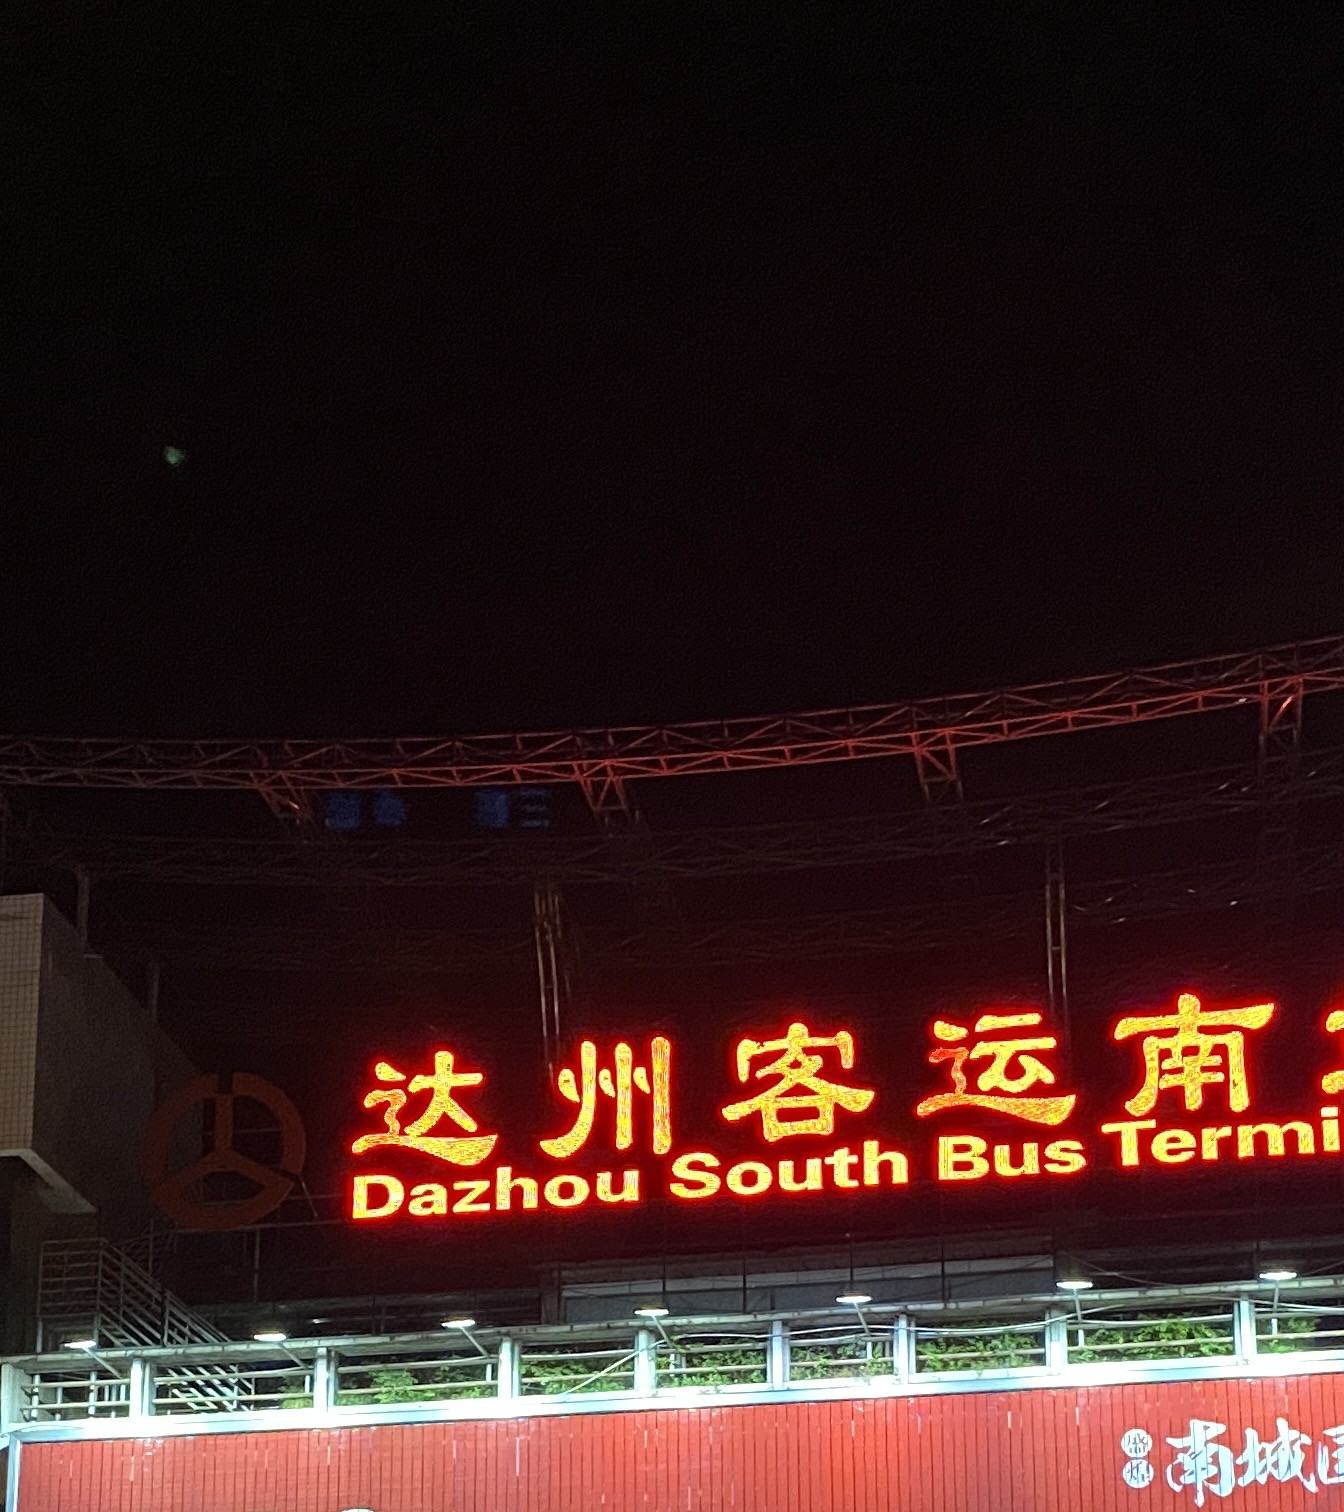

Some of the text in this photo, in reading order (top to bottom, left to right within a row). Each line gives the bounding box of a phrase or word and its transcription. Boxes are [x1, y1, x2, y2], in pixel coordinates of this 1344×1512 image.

[351, 1162, 641, 1221] Dazhou
[669, 1140, 910, 1200] South
[937, 1133, 1087, 1182] Bus
